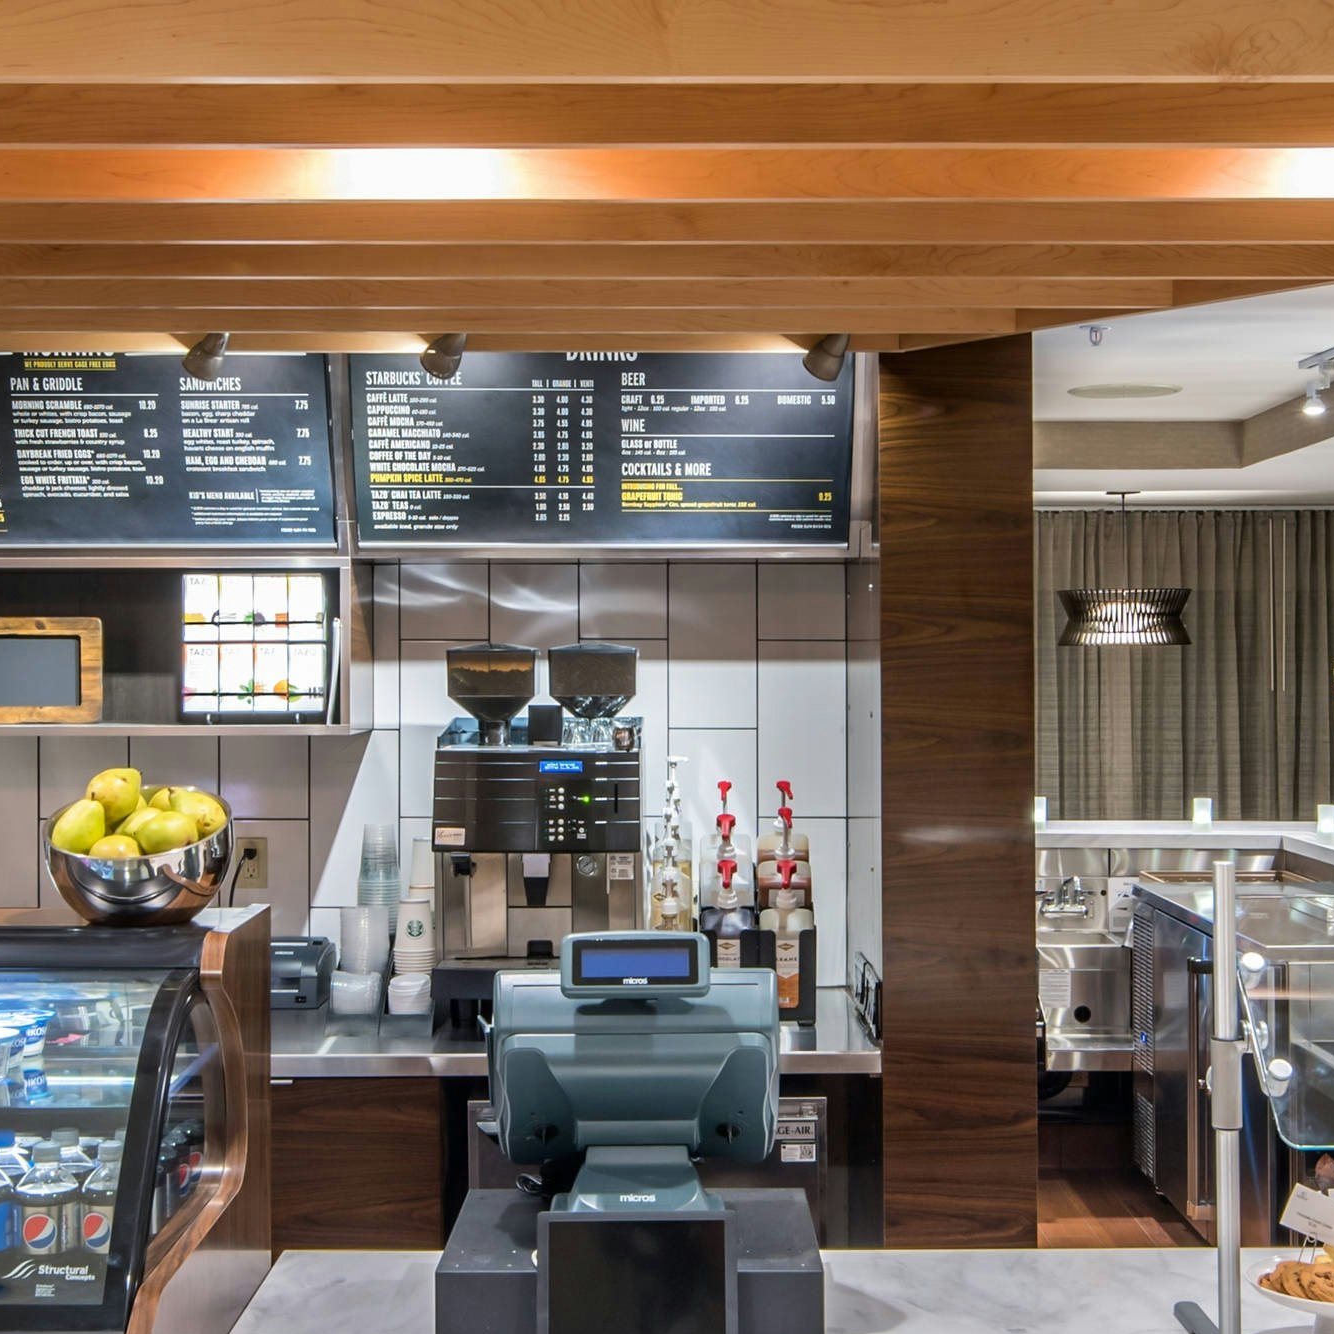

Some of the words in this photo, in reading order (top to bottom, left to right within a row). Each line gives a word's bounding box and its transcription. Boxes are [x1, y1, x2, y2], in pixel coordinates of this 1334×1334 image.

[10, 378, 29, 391] PAN
[33, 378, 40, 391] &
[43, 378, 83, 391] GRIDDLE
[179, 377, 241, 391] SANDWICHES
[366, 372, 421, 385] STARBUCKS
[621, 373, 645, 386] BEER
[389, 392, 407, 403] LATTE
[621, 419, 645, 432] WINE
[622, 463, 671, 476] COCKTAILS
[675, 463, 682, 476] &
[685, 463, 711, 476] MORE
[623, 977, 648, 985] micros
[778, 1126, 810, 1134] GE-AIR
[620, 1193, 656, 1202] micros
[38, 1265, 88, 1275] Structural
